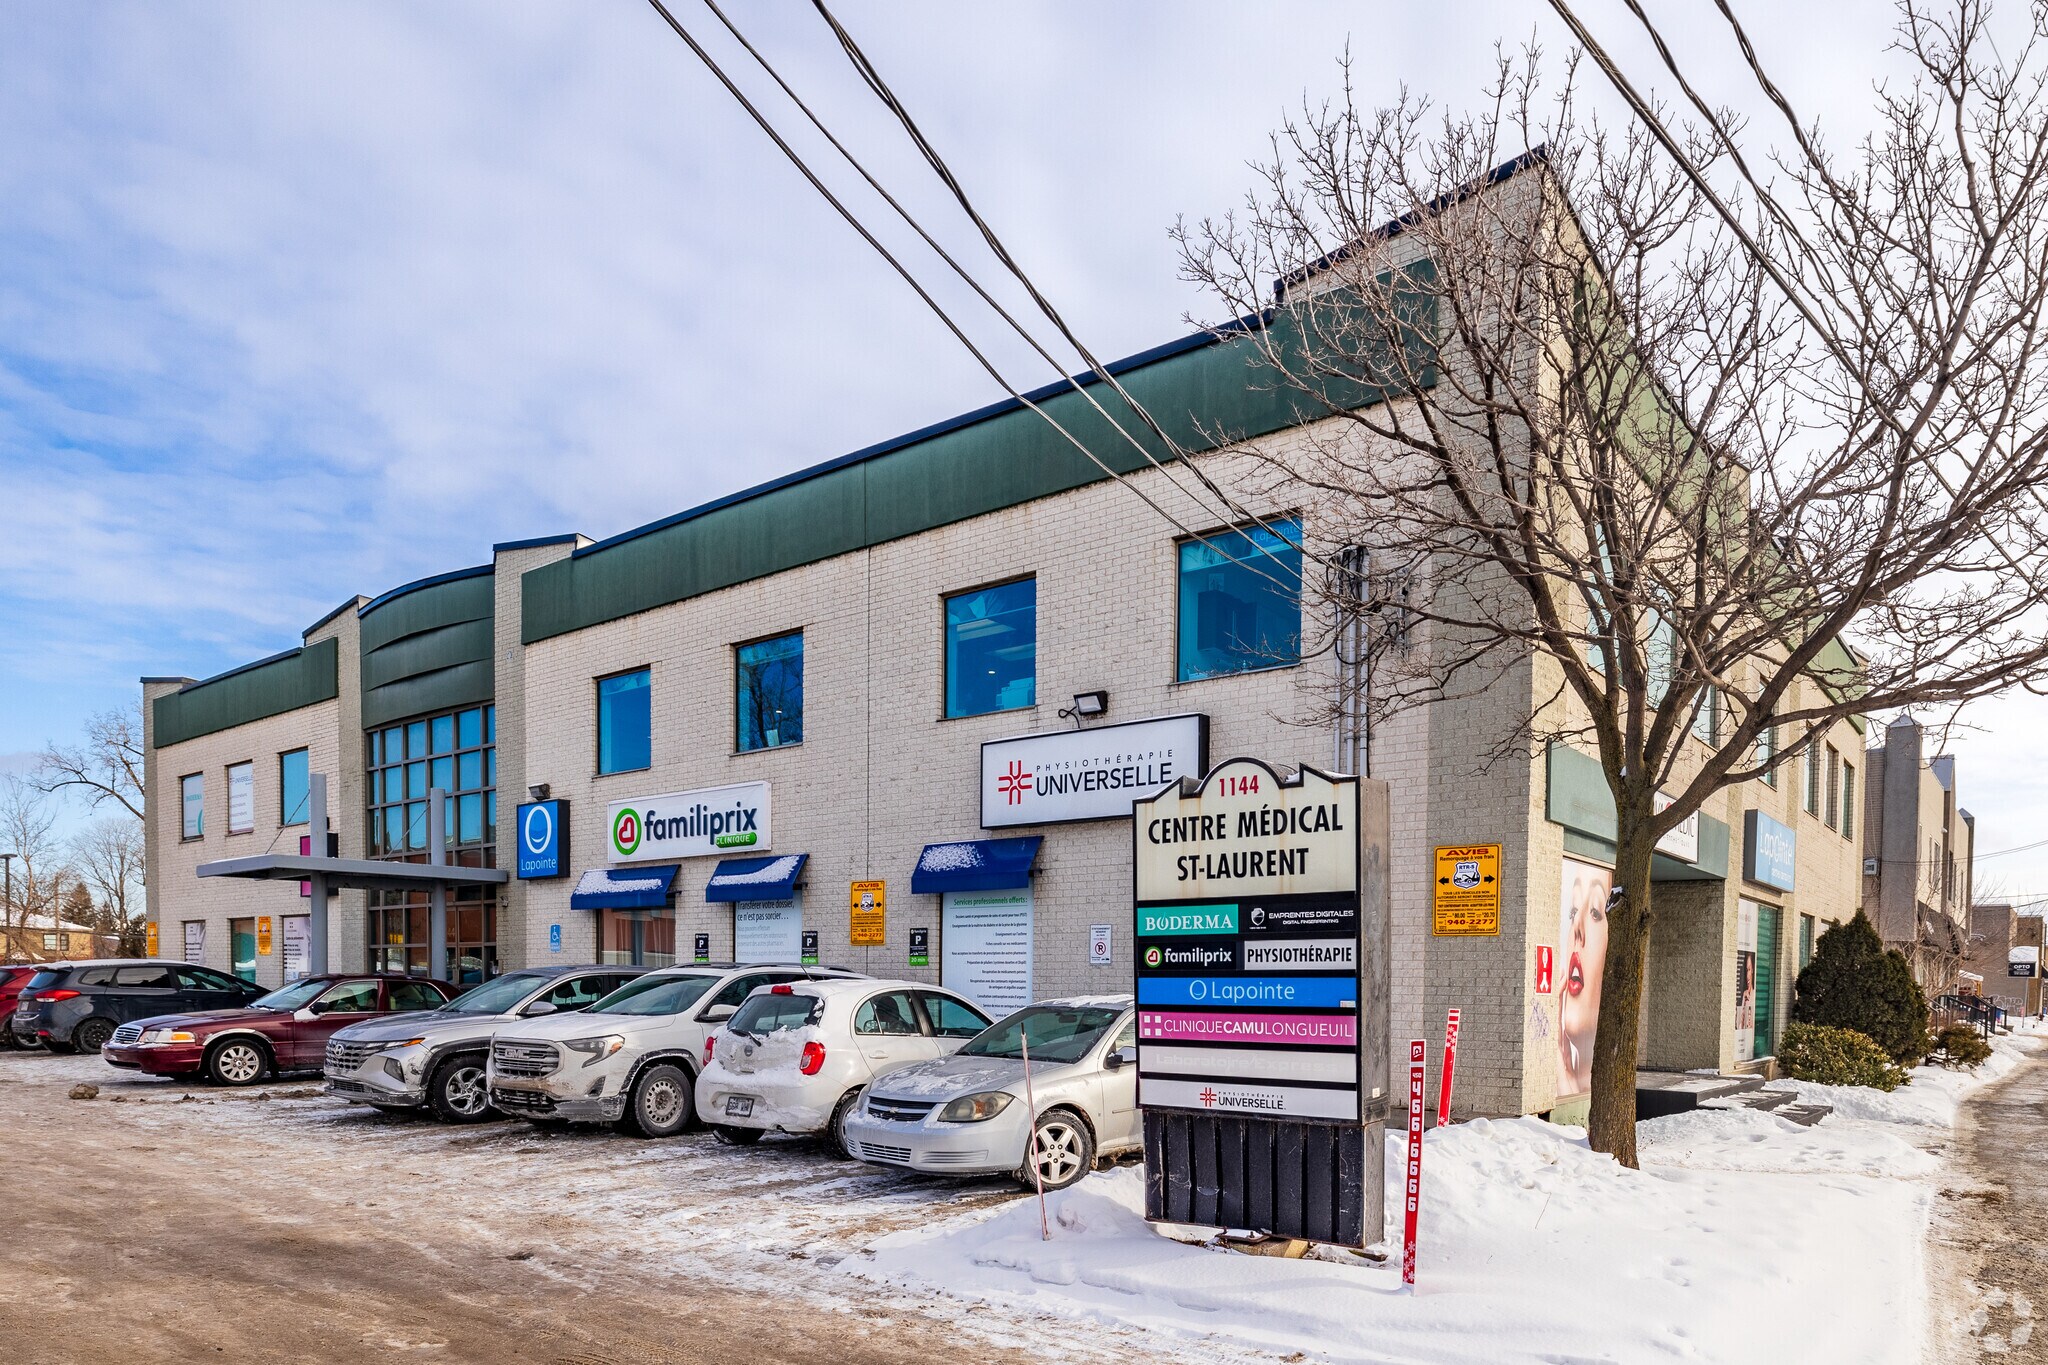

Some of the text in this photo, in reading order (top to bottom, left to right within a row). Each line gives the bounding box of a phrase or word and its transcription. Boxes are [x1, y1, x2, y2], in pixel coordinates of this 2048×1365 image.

[1036, 749, 1173, 772] PHYSIOTHÉRAPIE
[1036, 762, 1173, 797] UNIVERSELLE
[1219, 775, 1259, 797] 1144
[644, 801, 758, 846] familiprix
[1148, 804, 1344, 845] CENTRE MÉDICAL
[715, 834, 751, 846] CLINIQUE
[1446, 848, 1489, 856] AVIS
[521, 857, 557, 873] Lapointe
[1177, 847, 1310, 881] ST-LAURENT
[762, 900, 775, 909] votre
[953, 898, 973, 906] Services
[973, 896, 1008, 906] professionnels
[743, 912, 755, 921] n'est
[756, 913, 765, 923] pas
[1268, 910, 1354, 919] EMPREINTES DIGITALES
[1164, 945, 1232, 966] familiprix
[1247, 944, 1352, 963] PHYSIOTHÉRAPIE
[1212, 981, 1295, 1003] Lapointe
[505, 1048, 530, 1059] GMC
[1218, 1091, 1284, 1099] PHYSIOTHÉRAPIE
[1218, 1097, 1284, 1110] UNIVERSELLE
